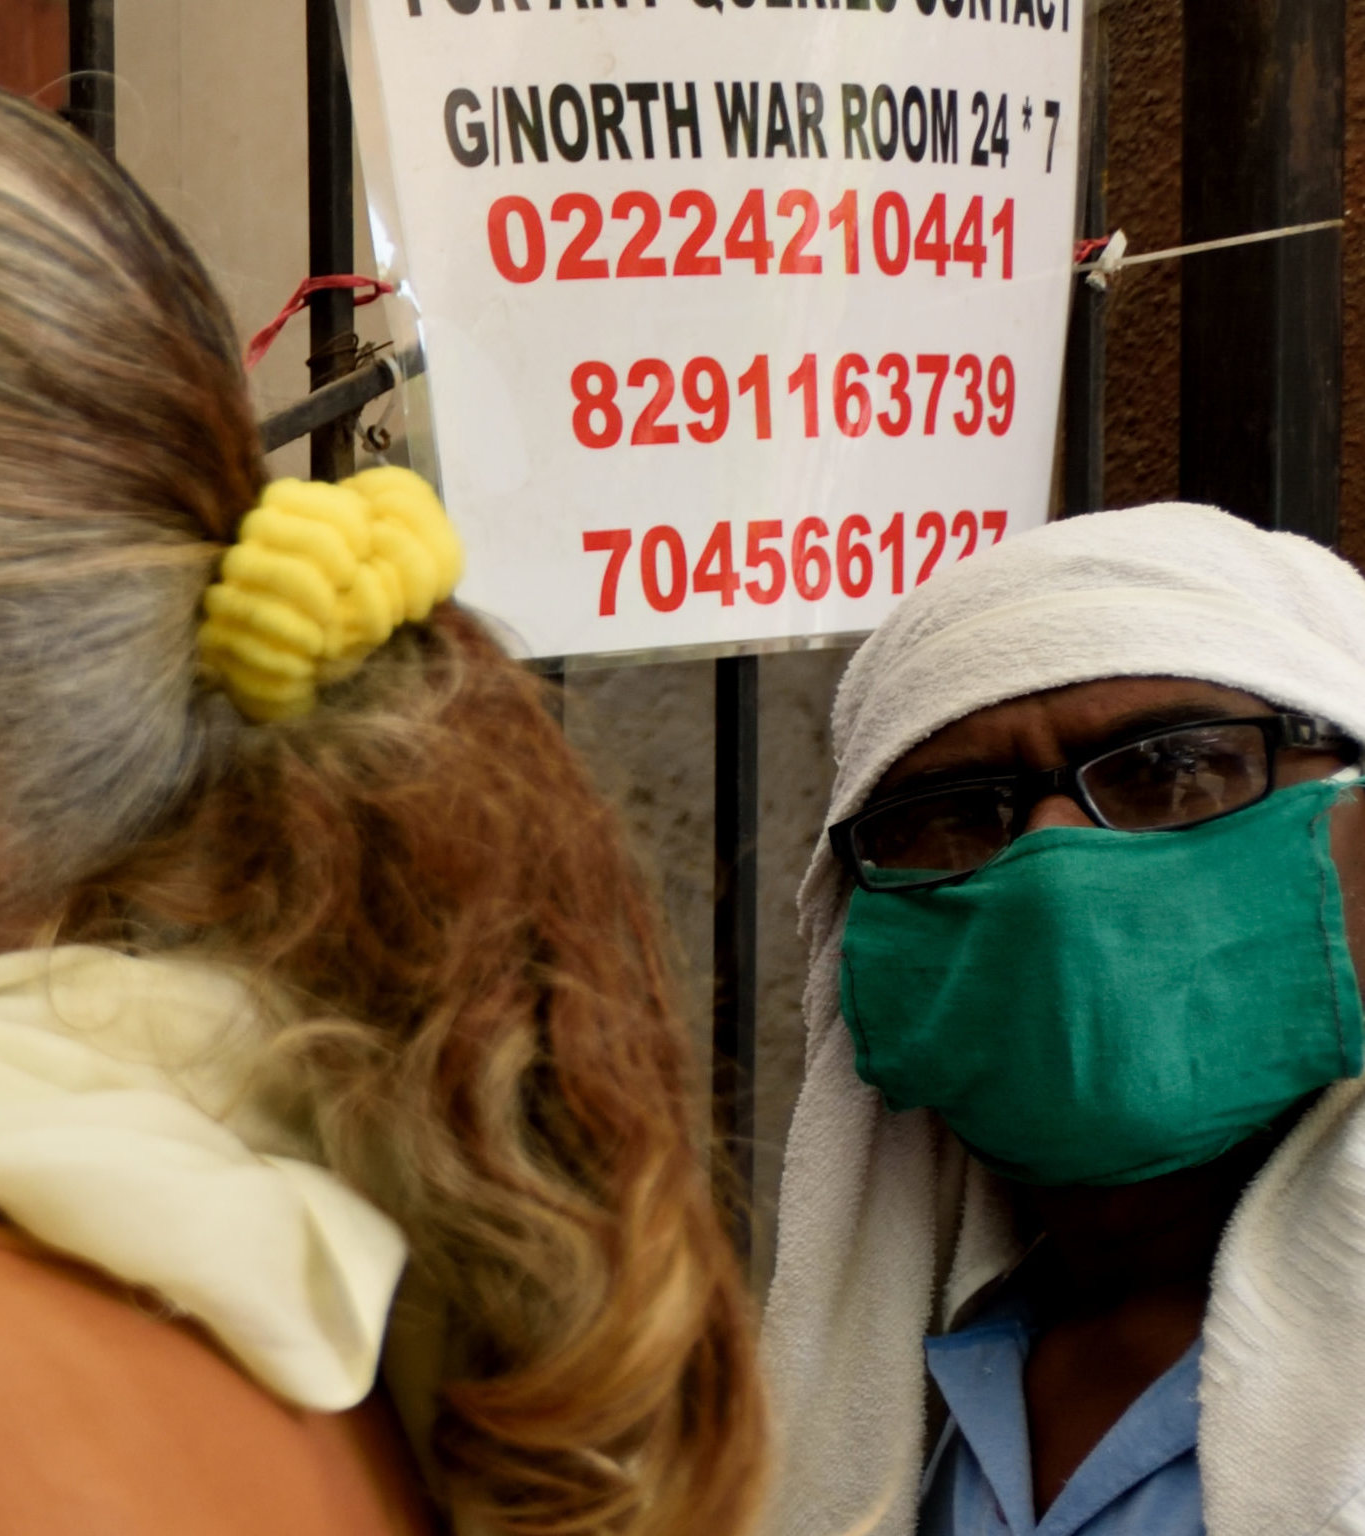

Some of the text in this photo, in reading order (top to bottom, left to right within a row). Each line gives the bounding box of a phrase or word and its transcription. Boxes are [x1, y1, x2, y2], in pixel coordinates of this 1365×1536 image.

[444, 81, 703, 168] G/NORTH
[714, 81, 829, 160] WAR
[842, 83, 959, 165] ROOM
[971, 91, 1010, 168] 24
[1043, 100, 1061, 174] 7
[486, 188, 1016, 285] 02224210441
[570, 352, 1016, 450] 8291163739
